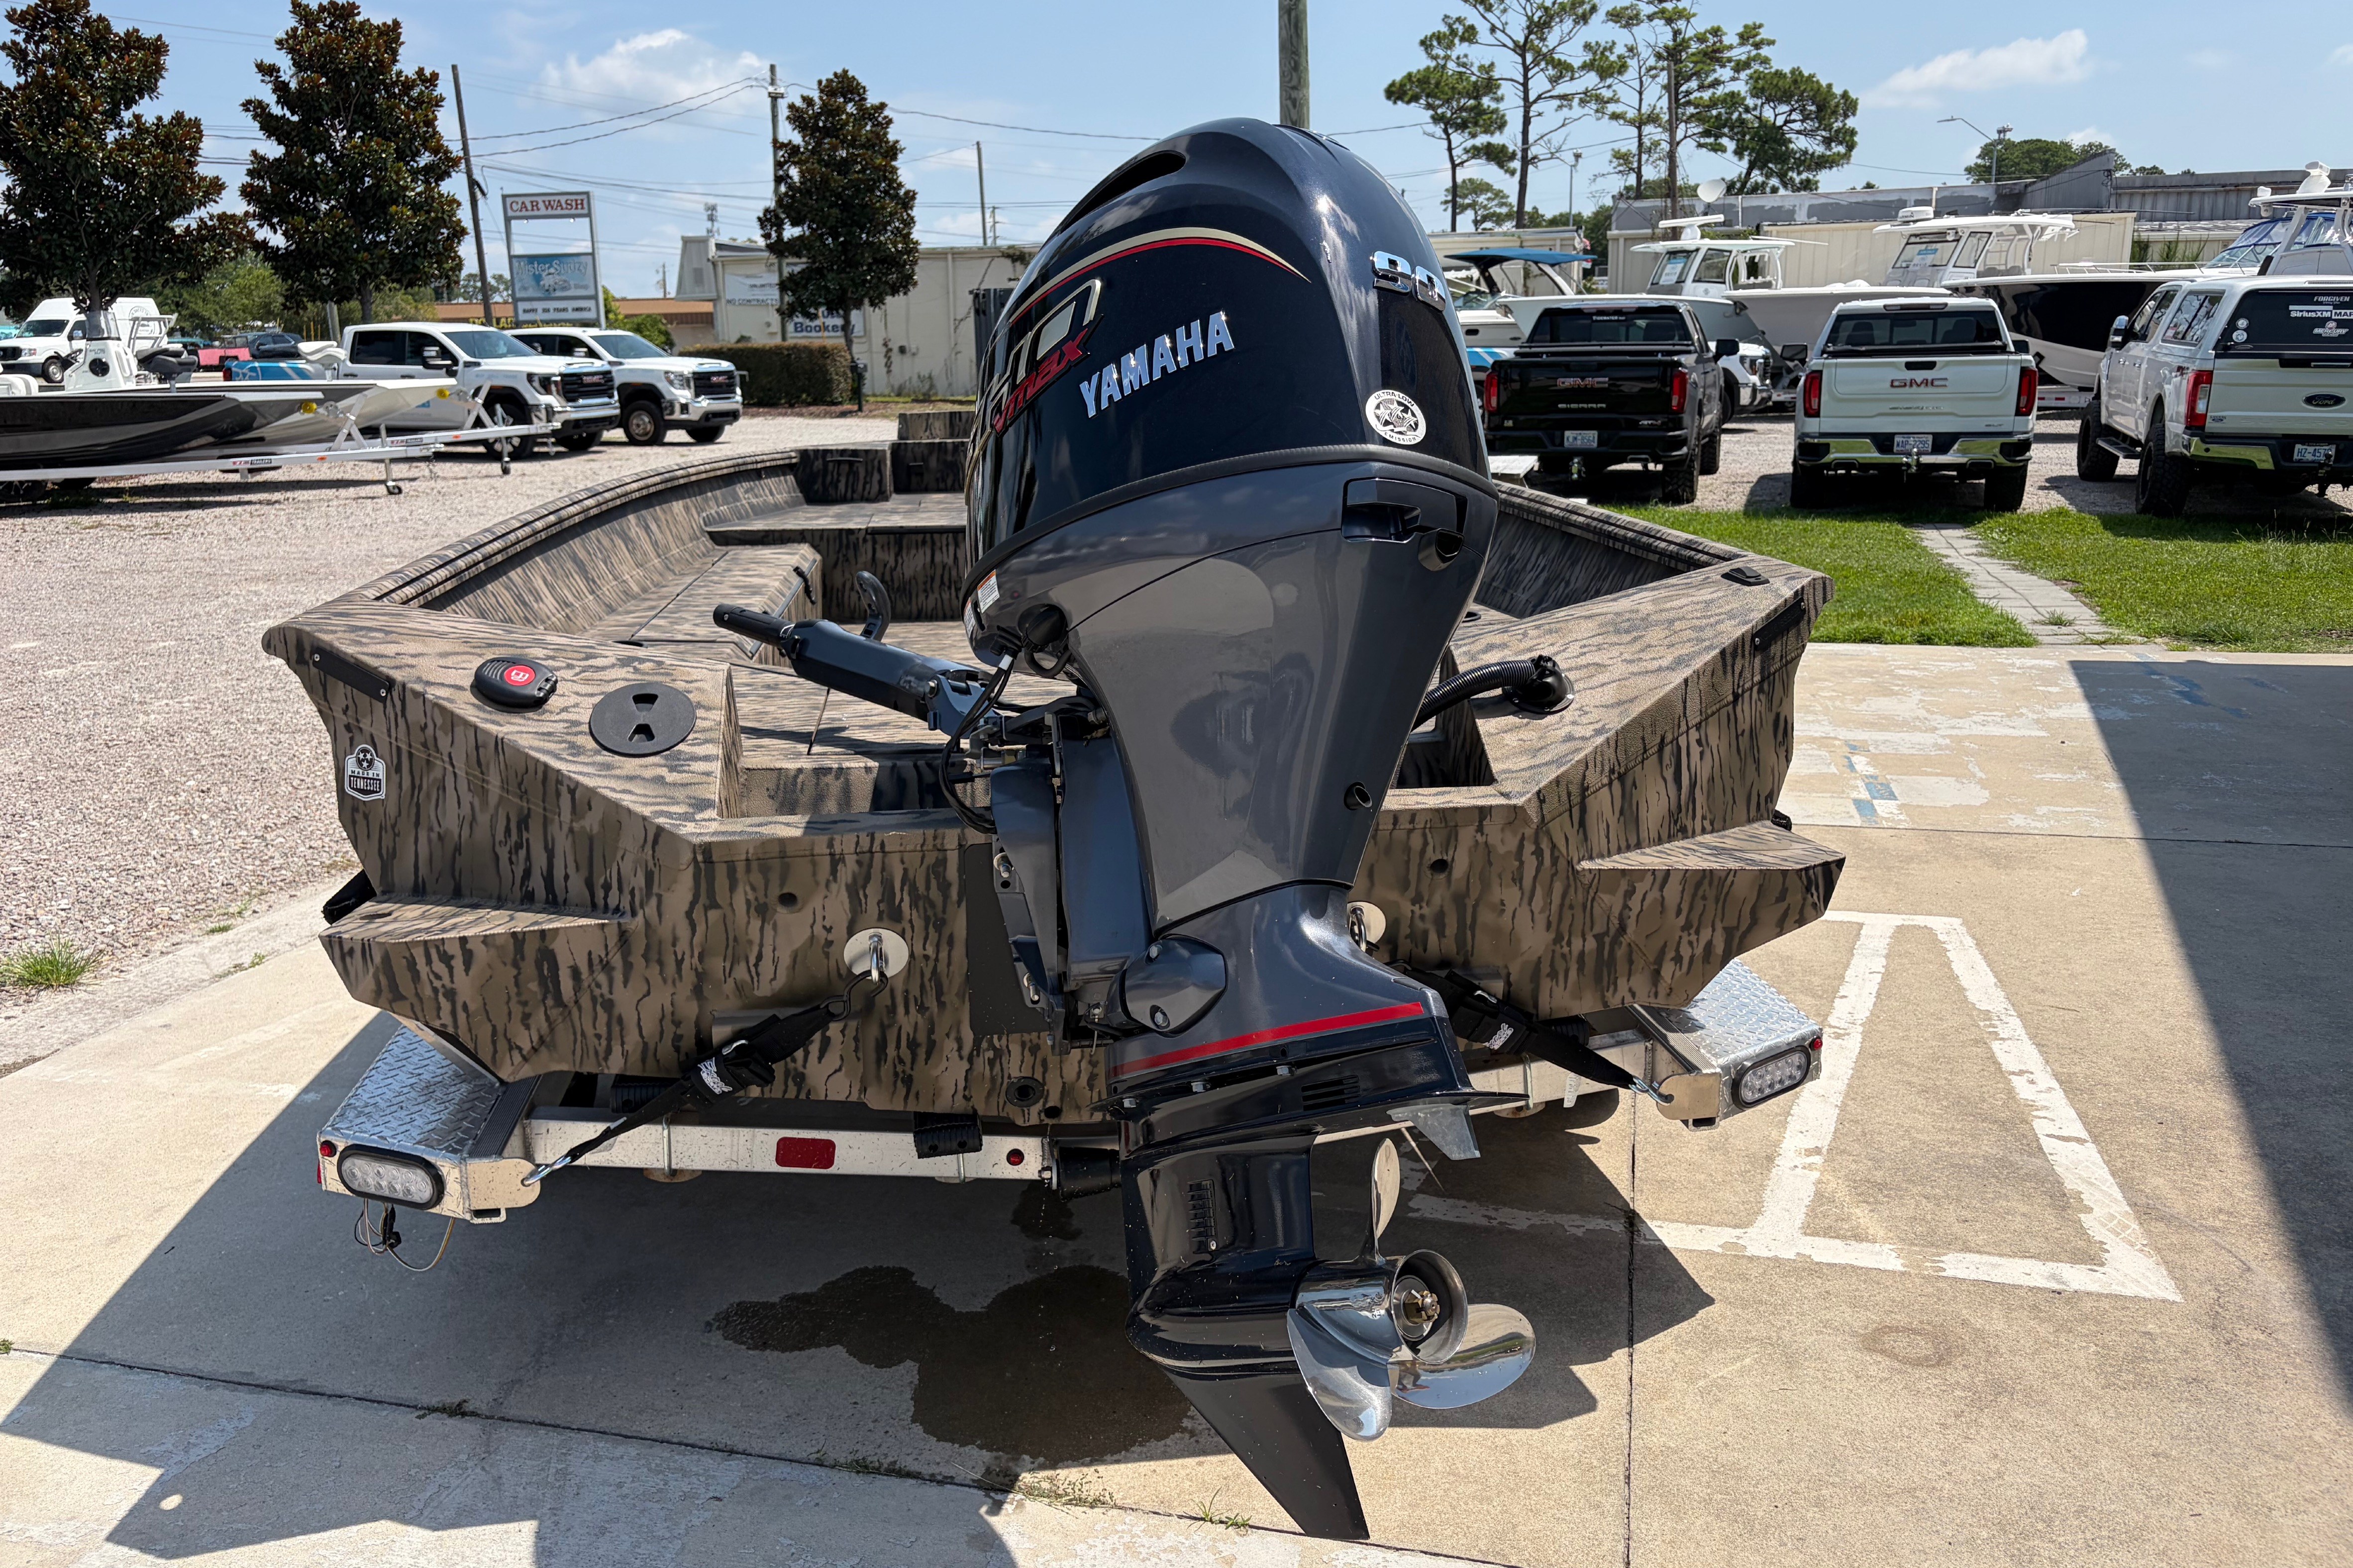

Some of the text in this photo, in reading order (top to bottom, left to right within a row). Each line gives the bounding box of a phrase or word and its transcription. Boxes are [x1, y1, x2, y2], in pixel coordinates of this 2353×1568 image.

[510, 198, 586, 212] CAR WASH
[1369, 251, 1446, 311] 90
[468, 317, 515, 329] DOLAR
[794, 321, 855, 335] Bookey
[1079, 310, 1234, 418] YAMAHA
[1557, 377, 1609, 388] GMC
[1890, 378, 1948, 389] GMC
[2311, 396, 2336, 405] Ford
[1384, 432, 1417, 442] EMISSION
[351, 777, 380, 792] TENNESSEE
